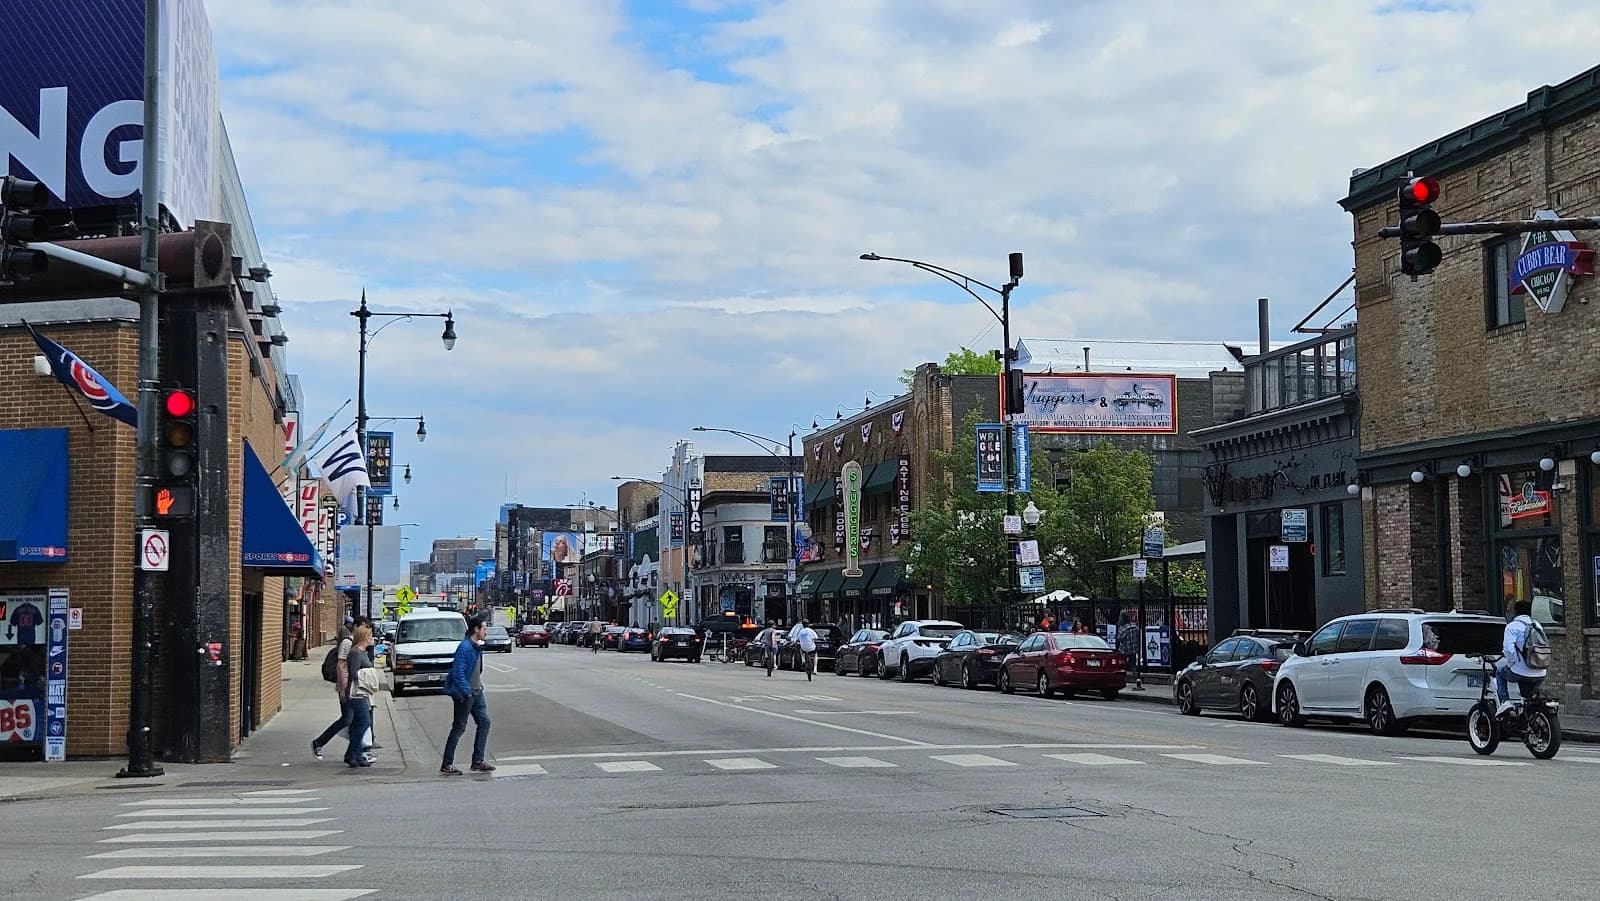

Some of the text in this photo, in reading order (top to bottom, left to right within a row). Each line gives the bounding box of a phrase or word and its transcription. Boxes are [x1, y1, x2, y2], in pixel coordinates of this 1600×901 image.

[1518, 245, 1566, 276] CUBBY BEAR
[1531, 272, 1554, 288] CHICAGO
[900, 460, 909, 502] BATTING
[690, 490, 701, 532] HVAC
[849, 471, 858, 557] SLUGGERS
[49, 685, 65, 695] HAT
